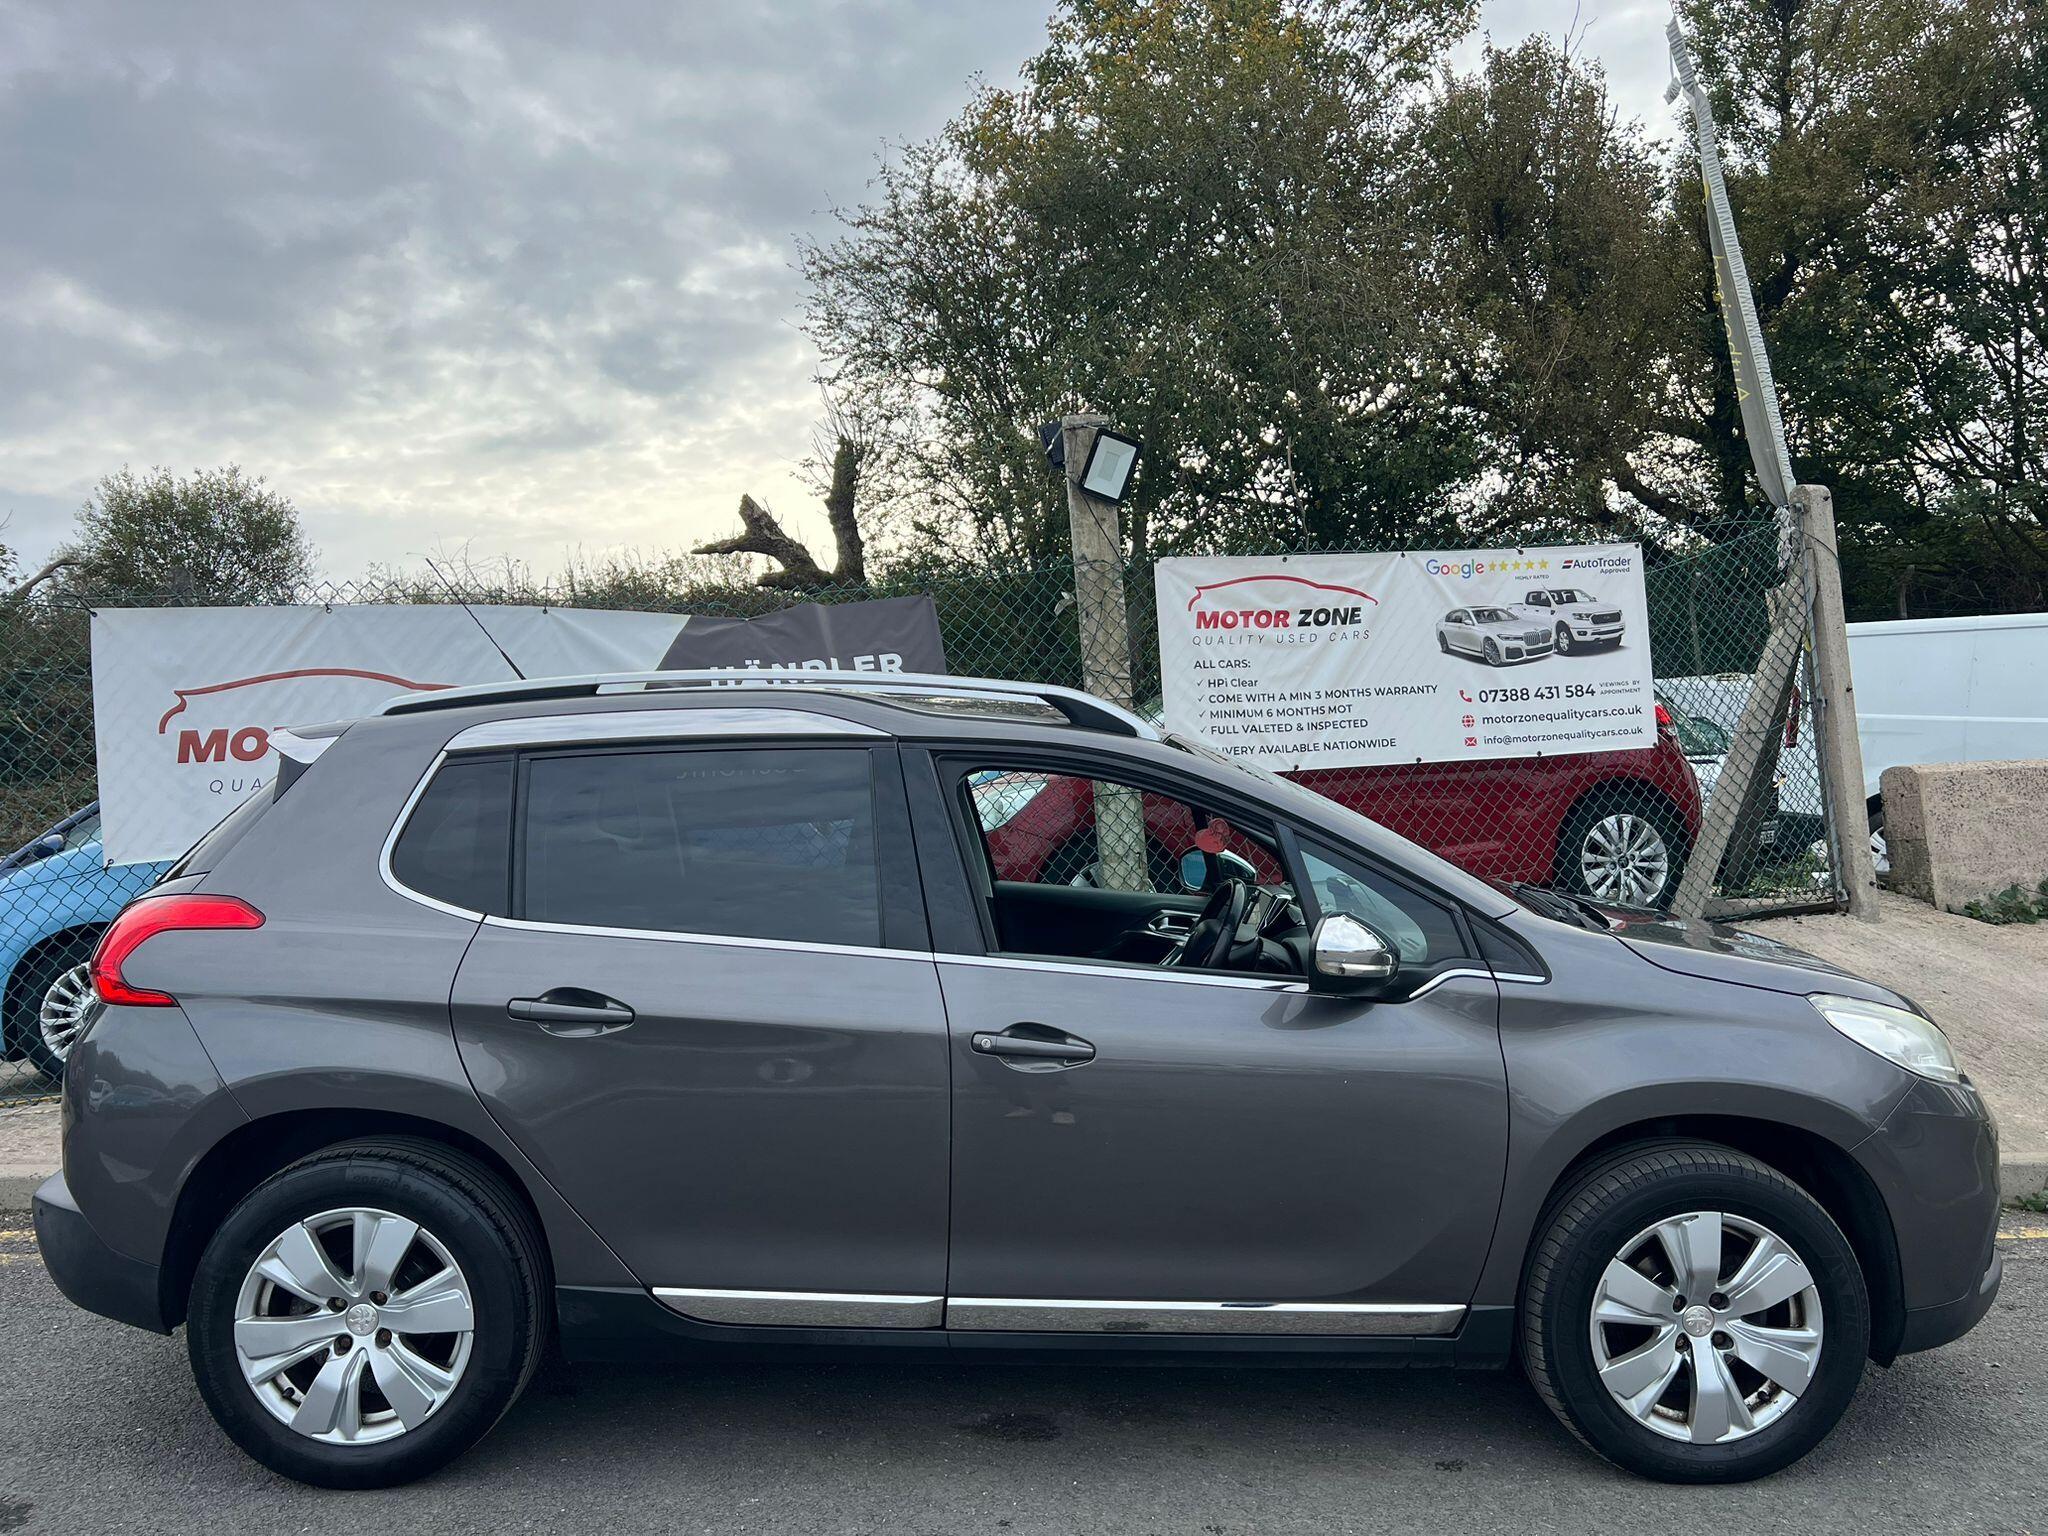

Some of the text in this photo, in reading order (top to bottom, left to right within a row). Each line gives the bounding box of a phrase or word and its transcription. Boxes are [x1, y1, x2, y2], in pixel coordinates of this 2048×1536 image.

[1426, 558, 1485, 579] Google
[1572, 556, 1632, 569] AutoTrader
[1600, 567, 1630, 576] Approved
[1196, 606, 1362, 629] MOTOR ZONE
[1192, 630, 1370, 647] QUALITY USED CARS
[1194, 659, 1251, 669] ALL CARS:
[1208, 678, 1258, 688] HPi Clear
[1599, 680, 1629, 688] VIEWINGS
[1600, 687, 1641, 695] APPOINTMENT
[1208, 685, 1438, 704] COME WITH A MIN 3 MONTHS WARRANTY
[1479, 683, 1596, 703] 07388 431 584
[1210, 704, 1353, 719] MINIMUM 6 MONTHS MOT
[1482, 705, 1642, 725] motorzonequalitycars.co.uk
[1211, 719, 1368, 735] FULL VALETED & INSPECTED
[1484, 726, 1643, 745] info@motorzonequalitycars.co.uk
[177, 727, 288, 763] MO
[1258, 742, 1320, 754] AVAILABLE
[1323, 738, 1397, 751] NATIONWIDE
